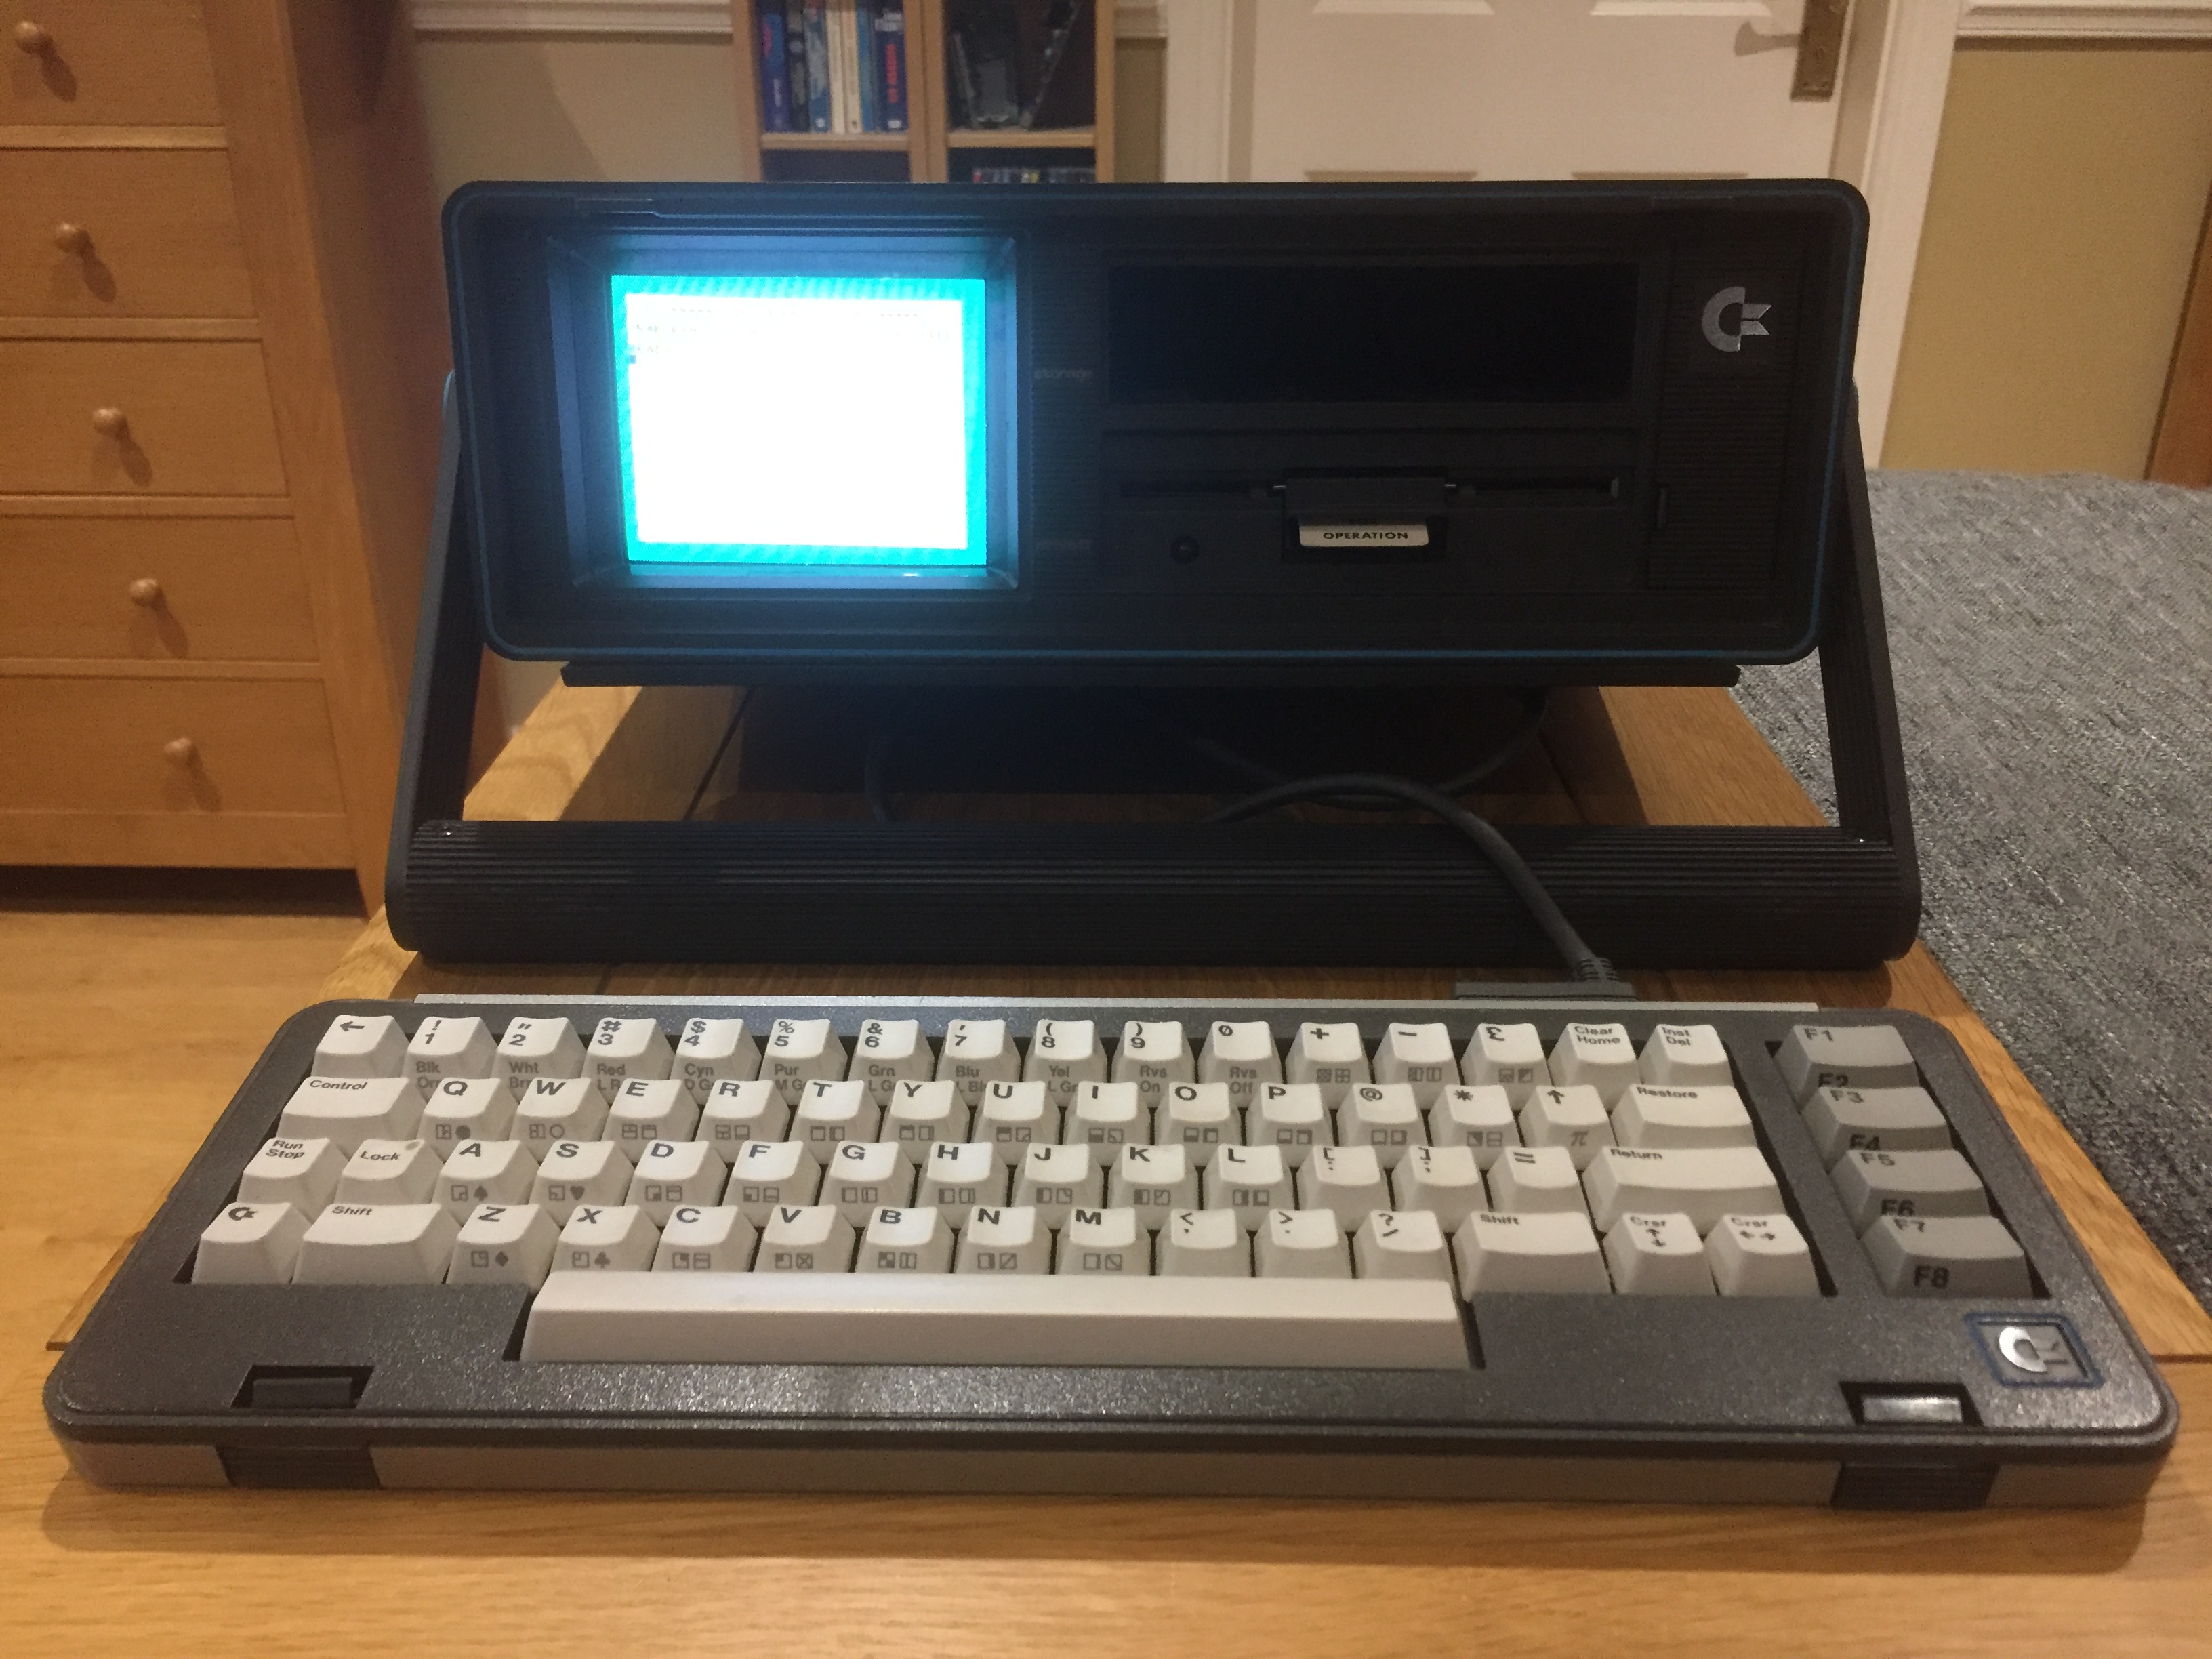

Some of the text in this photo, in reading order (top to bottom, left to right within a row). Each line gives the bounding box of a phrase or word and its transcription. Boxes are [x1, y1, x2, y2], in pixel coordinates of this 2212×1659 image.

[1323, 532, 1409, 540] OPERATION
[431, 1019, 441, 1030] !
[602, 1020, 622, 1032] #
[691, 1020, 707, 1033] $
[779, 1021, 795, 1034] %
[867, 1023, 883, 1035] &
[1046, 1023, 1053, 1036] (
[1136, 1023, 1143, 1036] )
[1574, 1025, 1614, 1036] Clear
[424, 1033, 435, 1044] 1
[598, 1033, 614, 1045] 3
[1310, 1027, 1330, 1040] +
[1486, 1027, 1505, 1042] £
[1662, 1027, 1692, 1038] Inst
[1804, 1028, 1835, 1042] F1
[509, 1033, 527, 1046] 2
[684, 1035, 701, 1046] 4
[775, 1036, 790, 1047] 5
[865, 1036, 880, 1048] 6
[955, 1035, 968, 1046] 7
[1041, 1036, 1056, 1048] 8
[1130, 1037, 1146, 1049] 9
[1577, 1035, 1621, 1045] Home
[1666, 1036, 1692, 1046] Del
[416, 1061, 441, 1073] Blk
[510, 1061, 539, 1073] Wht
[597, 1063, 626, 1076] Red
[684, 1063, 714, 1078] Cyn
[775, 1063, 799, 1076] Pur
[868, 1064, 895, 1076] Grn
[956, 1065, 981, 1077] Blu
[1049, 1065, 1070, 1078] Yel
[1139, 1065, 1167, 1078] Rvs
[1229, 1066, 1257, 1079] Rvs
[310, 1080, 368, 1090] Control
[598, 1079, 607, 1090] L
[684, 1079, 695, 1090] D
[775, 1079, 787, 1090] M
[868, 1080, 877, 1091] L
[1048, 1081, 1056, 1092] L
[1139, 1080, 1160, 1093] On
[1818, 1073, 1849, 1087] F2
[443, 1081, 468, 1096] Q
[537, 1080, 565, 1096] W
[626, 1081, 649, 1097] E
[718, 1082, 741, 1097] R
[813, 1082, 832, 1097] T
[903, 1082, 923, 1097] Y
[956, 1081, 964, 1093] L
[993, 1084, 1013, 1099] U
[1092, 1086, 1099, 1099] I
[1174, 1086, 1197, 1101] O
[1229, 1081, 1253, 1094] Off
[1268, 1086, 1286, 1100] P
[1637, 1086, 1698, 1099] Restore
[1360, 1087, 1383, 1101] @
[1830, 1090, 1864, 1104] F3
[272, 1140, 304, 1150] Run
[1849, 1134, 1881, 1151] F4
[266, 1149, 305, 1159] Stop
[360, 1151, 401, 1161] Lock
[459, 1143, 483, 1158] A
[556, 1143, 579, 1158] S
[650, 1143, 674, 1158] D
[749, 1144, 771, 1158] F
[842, 1145, 865, 1160] G
[937, 1145, 959, 1160] H
[1034, 1147, 1051, 1161] J
[1129, 1147, 1151, 1162] K
[1228, 1147, 1246, 1162] L
[1610, 1149, 1663, 1160] Return
[1514, 1151, 1536, 1164] =
[332, 1206, 372, 1216] Shift
[478, 1206, 507, 1222] Z
[1881, 1199, 1914, 1216] F6
[577, 1208, 602, 1224] X
[676, 1208, 701, 1223] C
[781, 1207, 802, 1223] V
[880, 1209, 902, 1224] B
[978, 1208, 1000, 1225] N
[1076, 1209, 1101, 1225] M
[1179, 1212, 1193, 1225] <
[1279, 1211, 1293, 1224] >
[1378, 1213, 1393, 1226] ?
[1479, 1214, 1521, 1225] Shift
[1894, 1218, 1925, 1233] F7
[1912, 1265, 1950, 1288] F8
